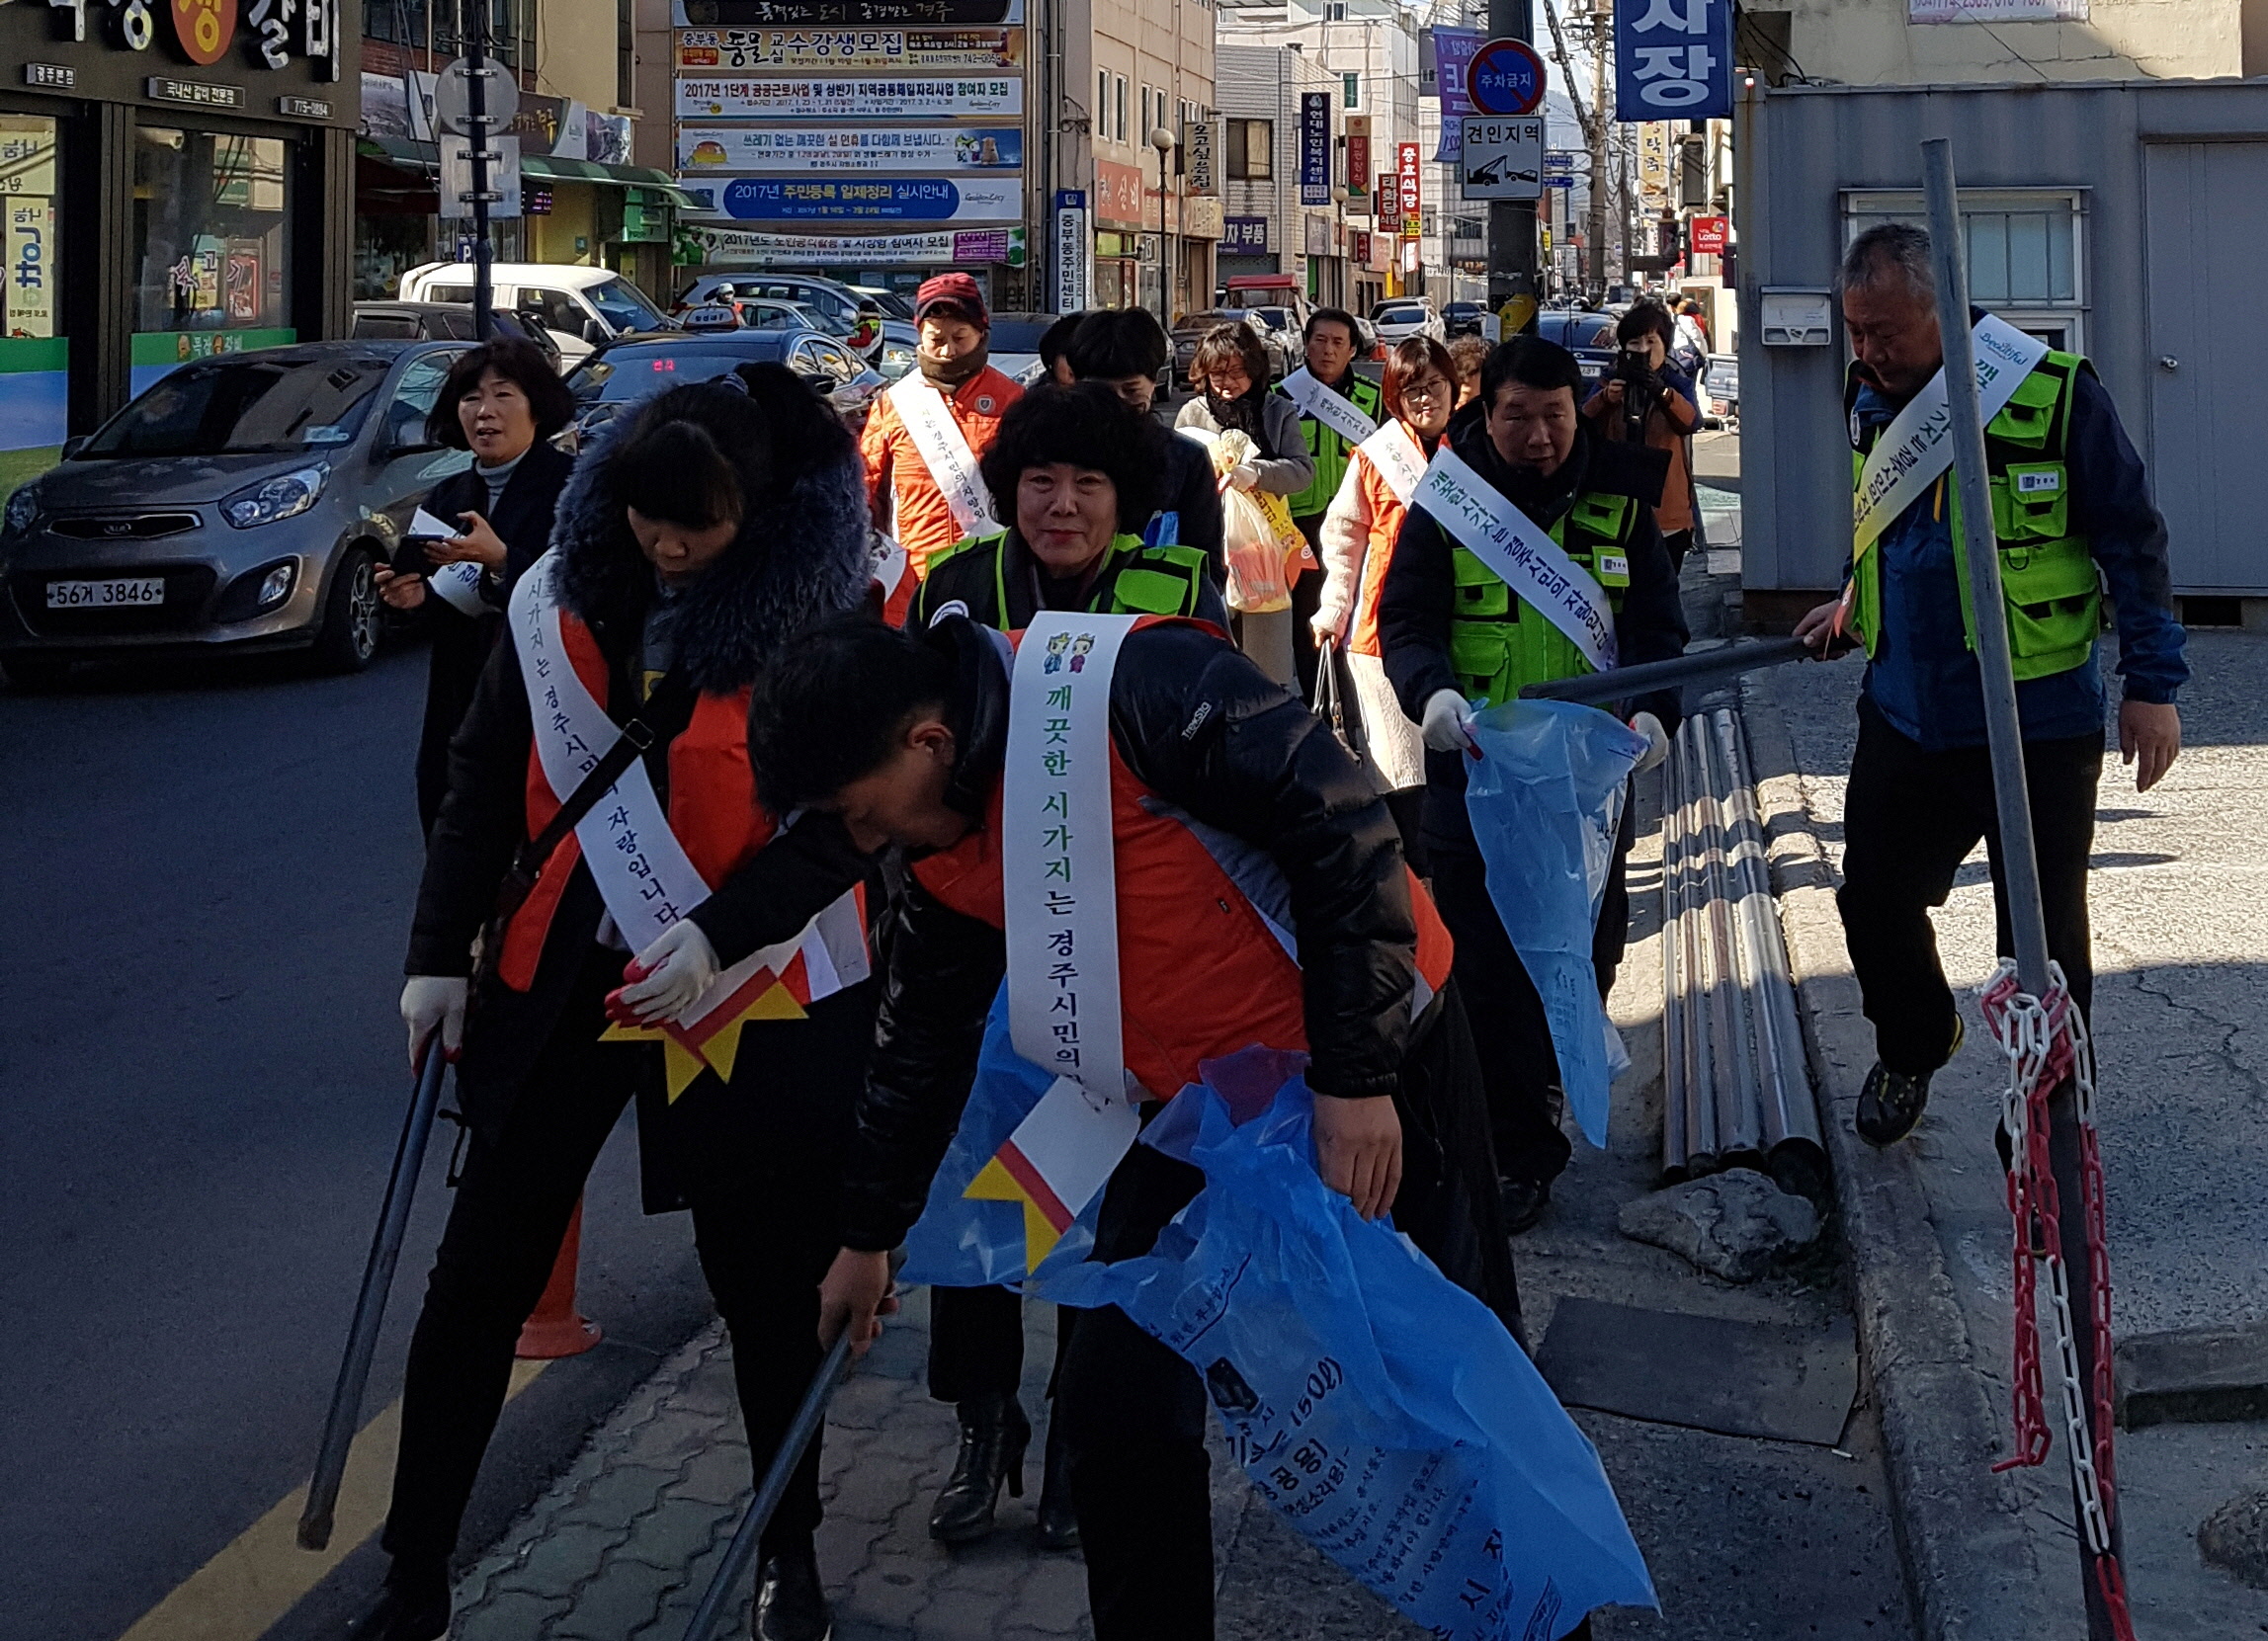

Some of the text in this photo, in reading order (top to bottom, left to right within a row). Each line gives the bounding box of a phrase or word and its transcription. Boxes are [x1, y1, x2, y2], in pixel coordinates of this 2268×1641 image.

[818, 4, 846, 21] 도시
[683, 32, 718, 46] 중부동
[718, 32, 770, 67] 풍물
[788, 32, 902, 55] 수강생모집
[166, 81, 193, 100] 국내산
[685, 83, 720, 98] 2017년
[723, 83, 749, 97] 1단계
[752, 83, 809, 97] 공공근로사업
[812, 83, 822, 97] 및
[957, 82, 986, 96] 참여자
[989, 82, 1009, 96] 모집
[1480, 72, 1531, 89] 주차금지
[743, 134, 772, 147] 쓰레기
[1468, 123, 1539, 144] 견인지역
[735, 184, 950, 200] 2017년 주민등록 일제정리 실시안내
[723, 233, 771, 246] 2017년도
[927, 236, 949, 248] 모집
[1242, 222, 1265, 245] 부품
[1698, 232, 1722, 241] Lotto
[1060, 213, 1075, 310] 중부동주민센터
[1979, 332, 2029, 367] Beautiful
[1868, 446, 1919, 507] 경주시민의
[1430, 470, 1610, 651] 깨끗한 시가지는 경주시민의 자랑입니다
[56, 581, 153, 605] 56거 3846
[527, 578, 551, 679] 시가지는
[607, 805, 682, 927] 자랑입니다
[1041, 684, 1082, 1068] 깨끗한 시가지는 경주시민의
